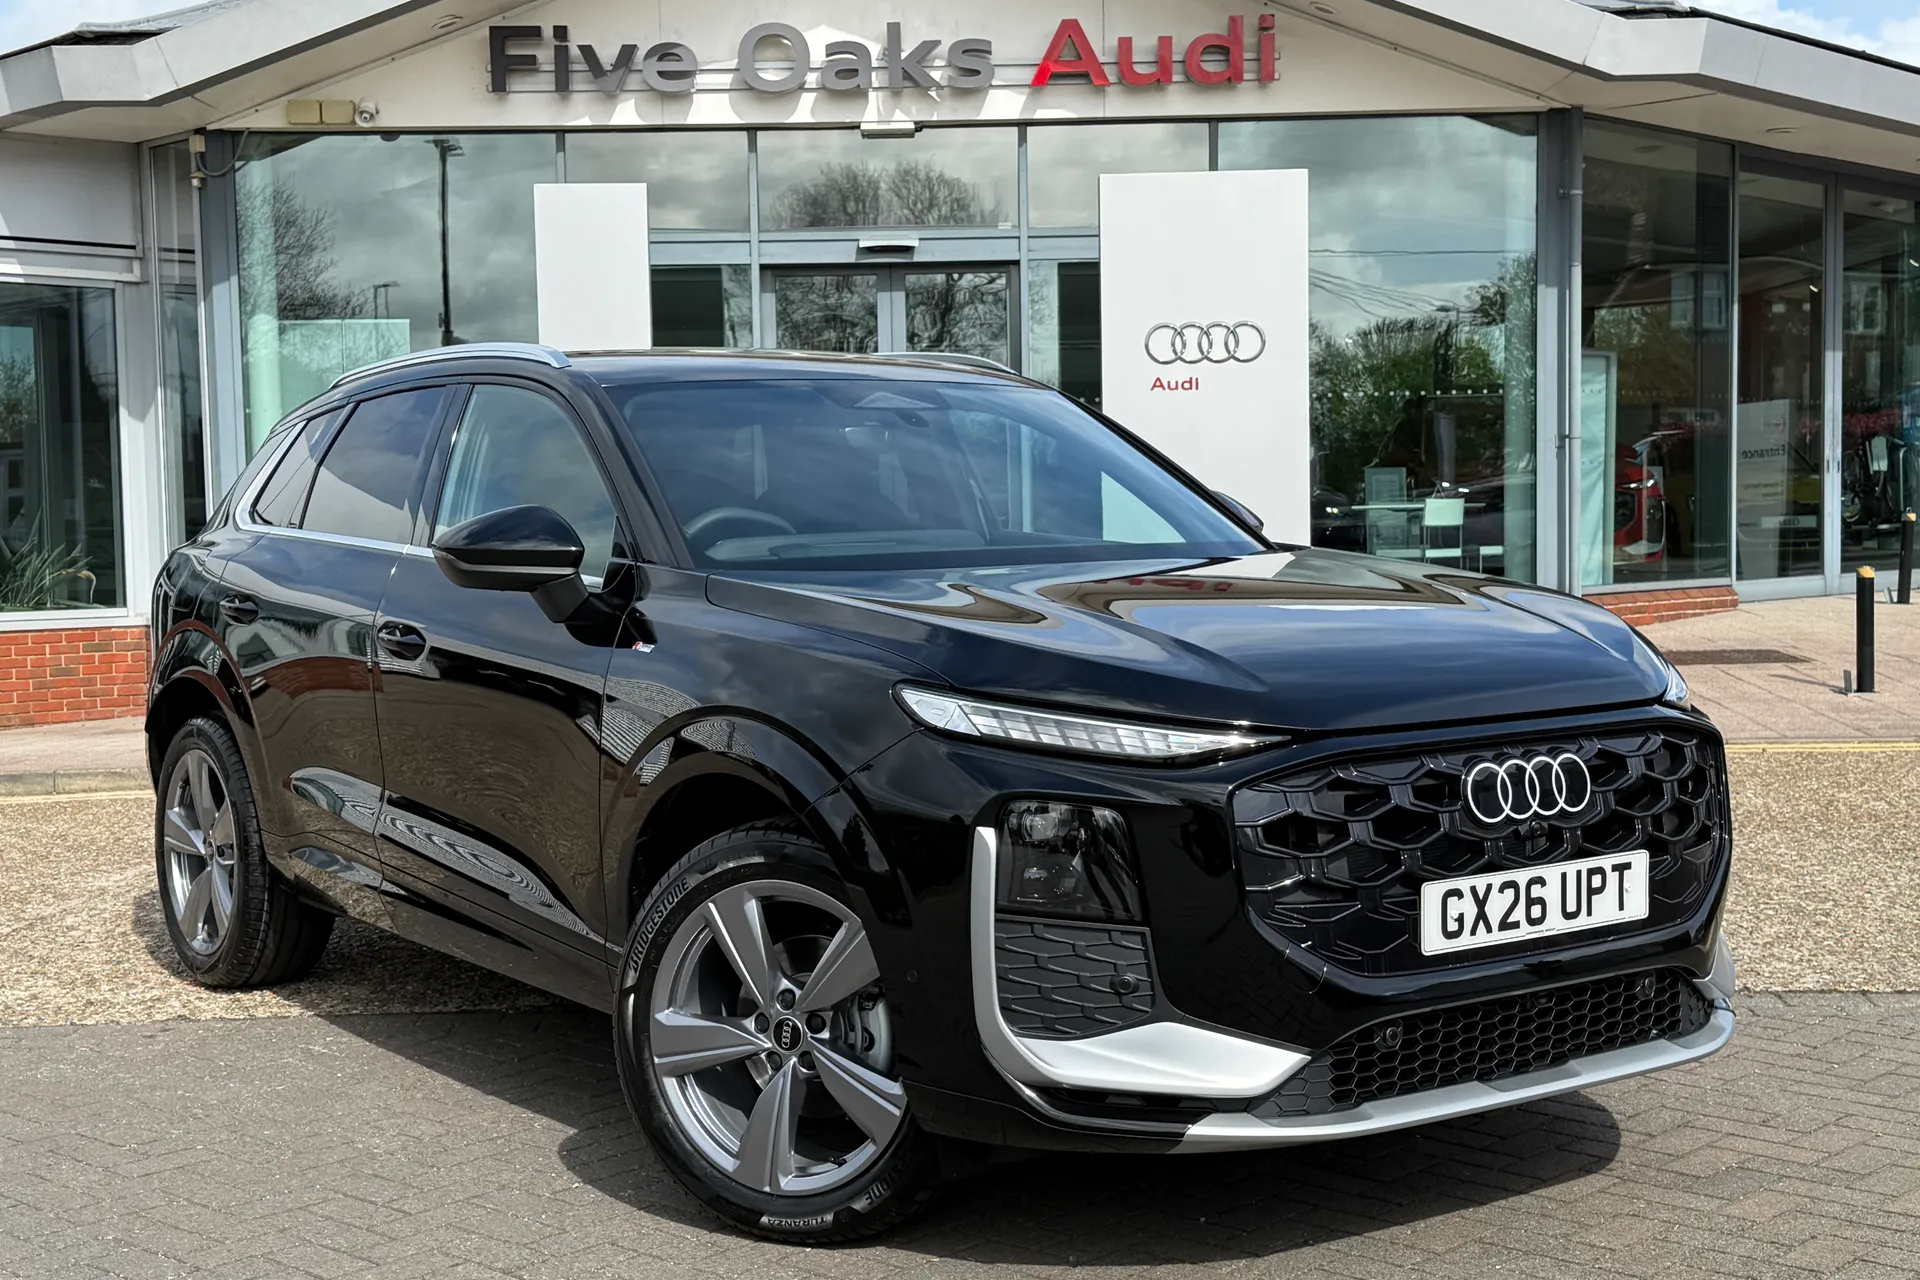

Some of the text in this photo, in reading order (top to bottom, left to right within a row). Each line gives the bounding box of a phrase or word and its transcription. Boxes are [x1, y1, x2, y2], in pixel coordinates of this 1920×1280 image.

[489, 13, 1276, 93] Five Oaks Audi
[1150, 376, 1199, 391] Audi
[628, 877, 690, 975] BRIDGESTONE
[1441, 861, 1633, 941] GX26 UPT
[767, 1216, 828, 1228] TURANZA
